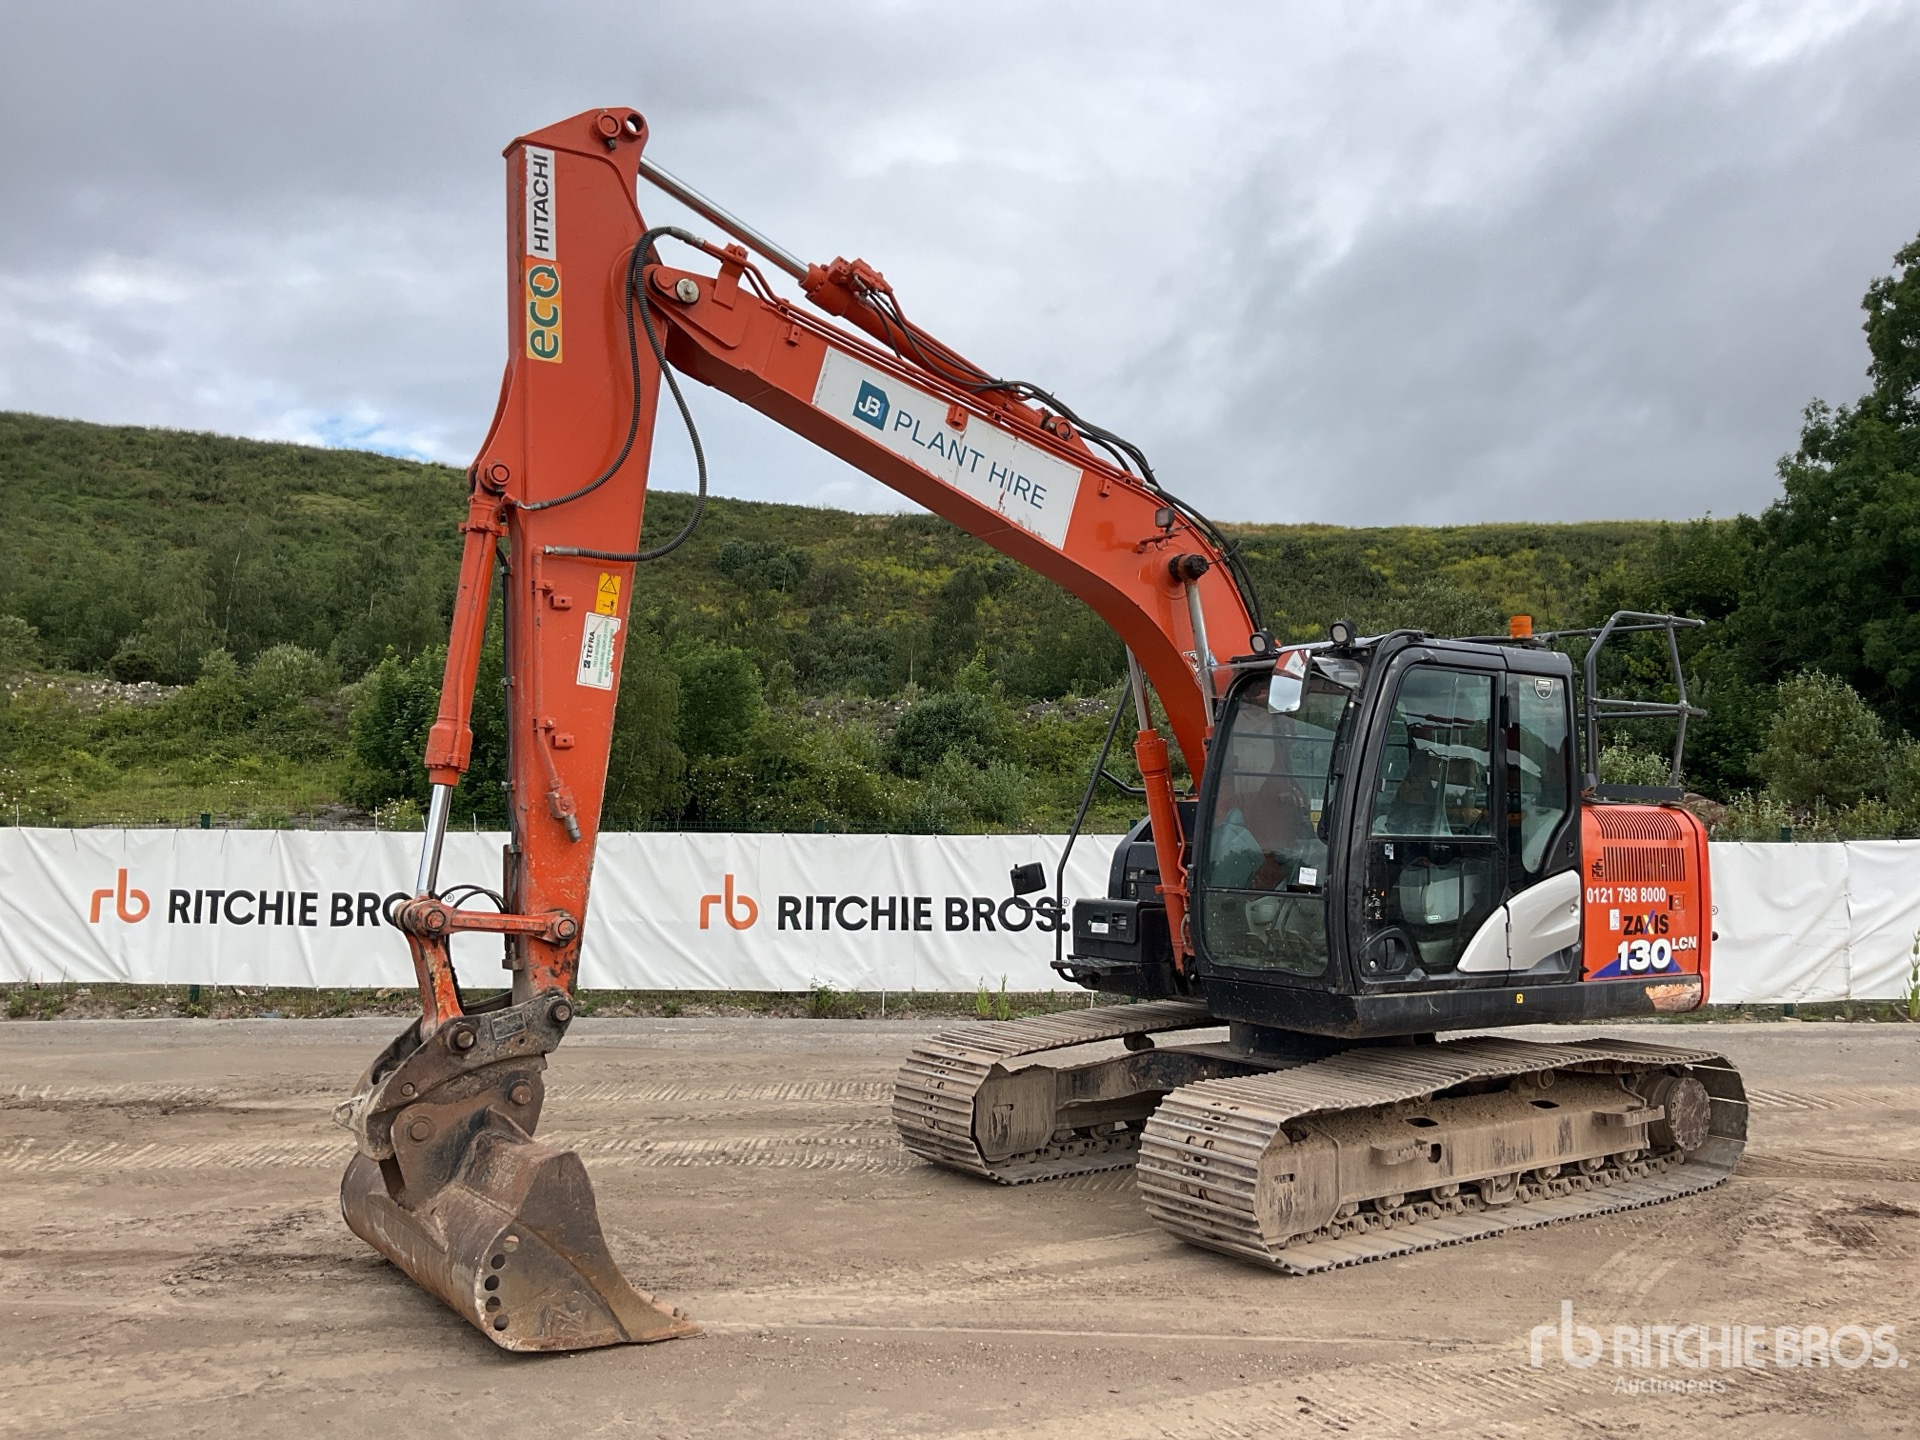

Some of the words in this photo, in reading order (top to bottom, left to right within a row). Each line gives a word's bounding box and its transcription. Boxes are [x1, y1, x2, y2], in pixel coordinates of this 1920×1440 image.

[533, 154, 549, 252] HITACHI
[528, 264, 560, 359] eco
[893, 409, 985, 474] PLANT
[988, 461, 1047, 510] HIRE
[586, 631, 595, 658] TEFRA
[89, 868, 151, 924] rb
[168, 889, 318, 927] RITCHIE
[330, 891, 413, 928] BRO
[699, 874, 758, 930] rb
[777, 895, 933, 932] RITCHIE
[1586, 886, 1613, 904] 0121
[1617, 886, 1638, 904] 798
[1640, 886, 1667, 903] 8000
[1623, 909, 1669, 935] ZAXIS
